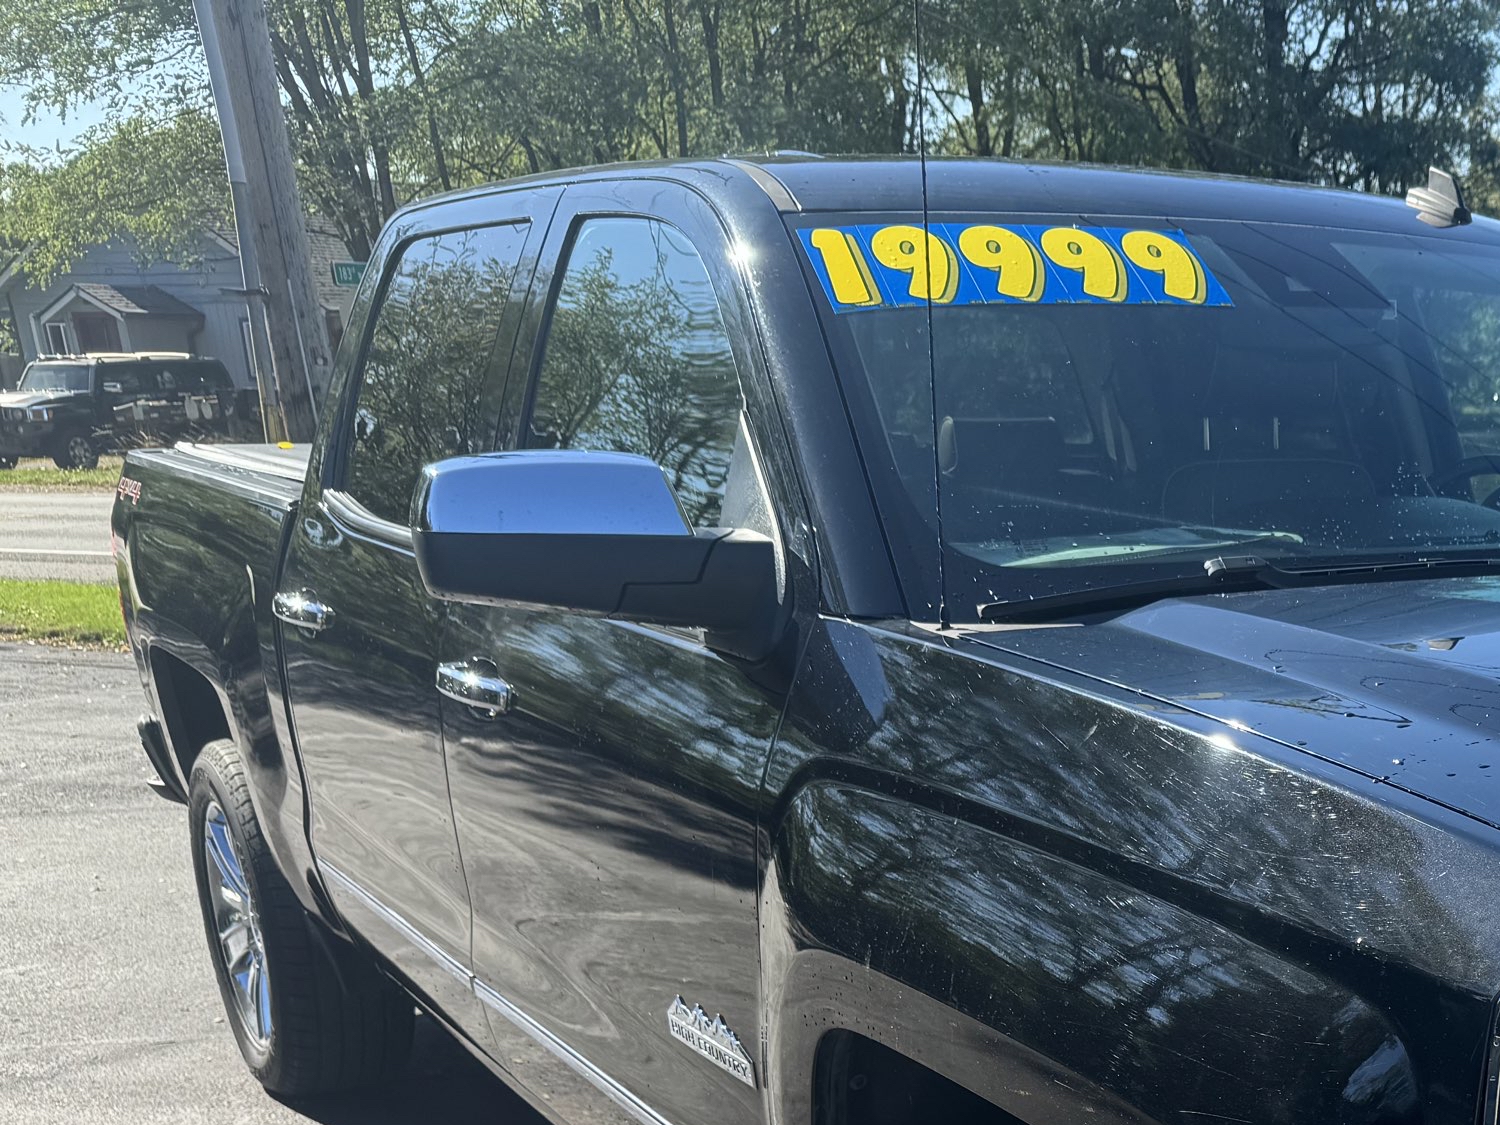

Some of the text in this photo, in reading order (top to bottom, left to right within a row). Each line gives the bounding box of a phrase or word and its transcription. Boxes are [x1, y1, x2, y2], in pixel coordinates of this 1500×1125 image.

[811, 225, 1207, 304] 19999
[671, 1019, 748, 1078] HIGH COUNTRY
